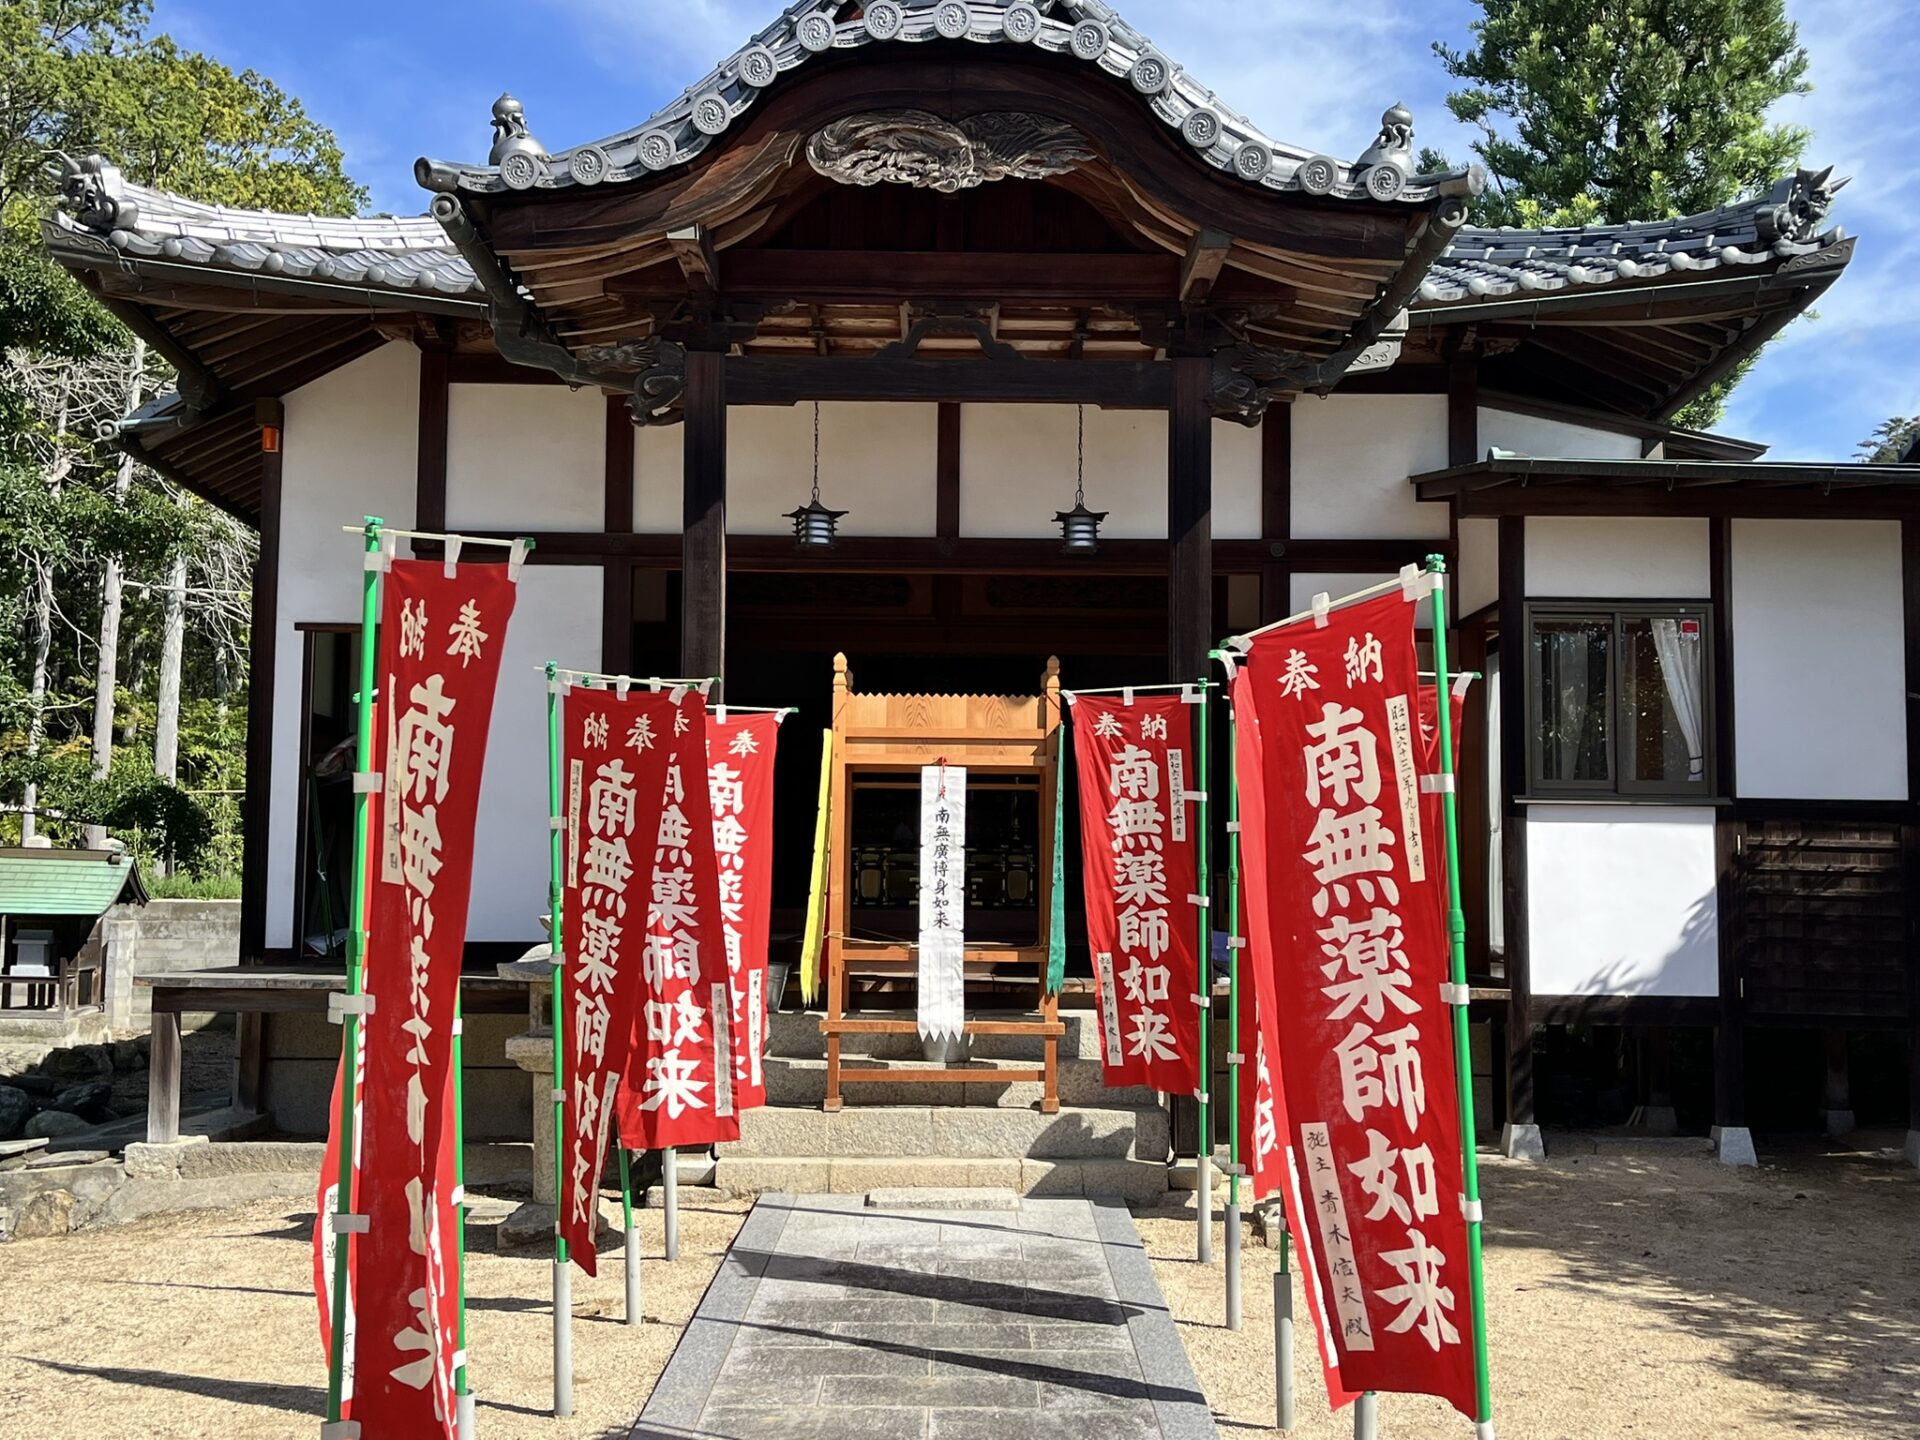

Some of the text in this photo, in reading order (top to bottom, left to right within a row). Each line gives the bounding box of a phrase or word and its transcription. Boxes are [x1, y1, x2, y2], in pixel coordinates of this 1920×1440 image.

[1093, 711, 1168, 741] 奉納
[1277, 631, 1384, 701] 奉納
[932, 806, 951, 929] 南無廣博身如来
[1106, 743, 1182, 1066] 南無薬師如来
[1301, 701, 1461, 1353] 南無薬師如来
